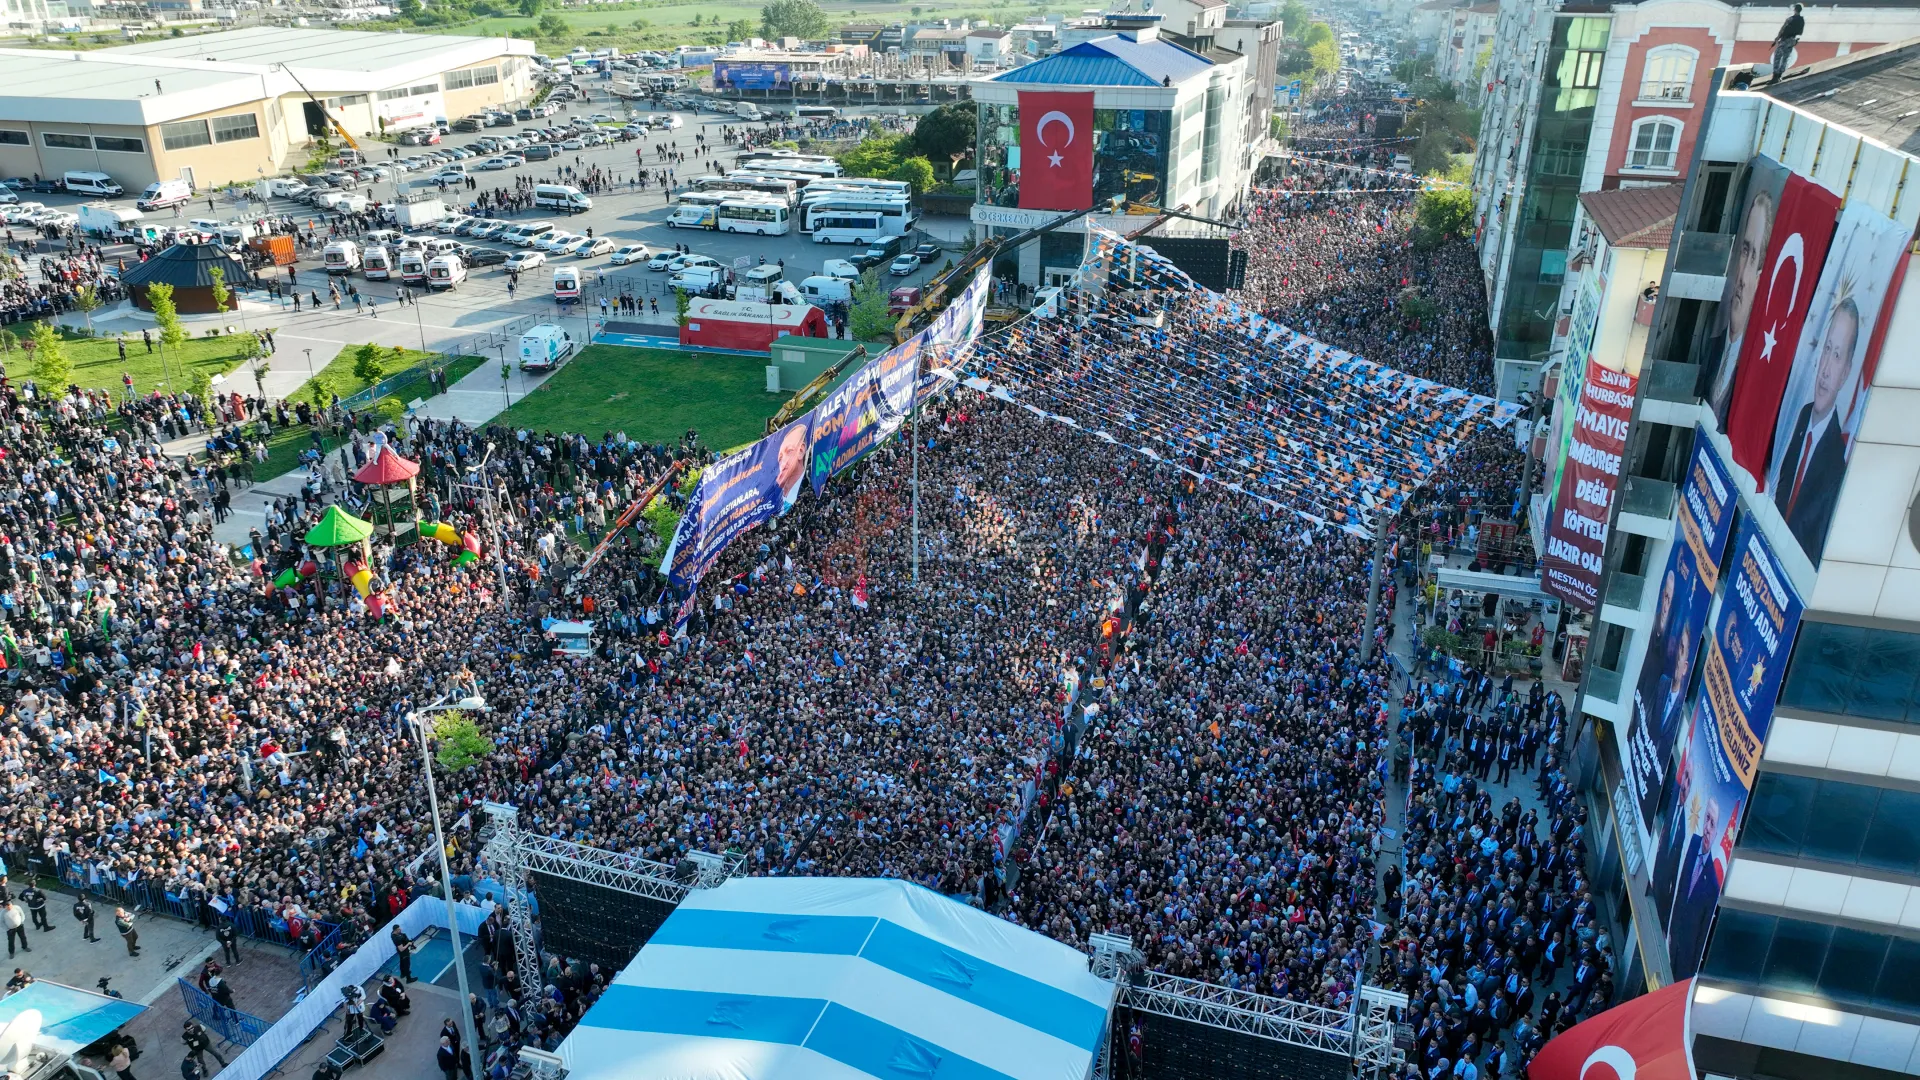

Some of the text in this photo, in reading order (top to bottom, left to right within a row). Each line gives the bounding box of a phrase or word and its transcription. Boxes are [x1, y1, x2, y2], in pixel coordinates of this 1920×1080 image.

[712, 309, 738, 318] SAĞLIK
[1600, 369, 1631, 389] SAYIN
[1575, 478, 1608, 508] DEĞİL
[1548, 535, 1602, 576] HAZIR OLA
[1548, 568, 1585, 591] MESTAN
[1735, 571, 1759, 620] DOĞRU
[1754, 610, 1779, 659] ADAM
[1760, 586, 1785, 635] ZAMAN
[1723, 723, 1751, 777] GELDİNİZ
